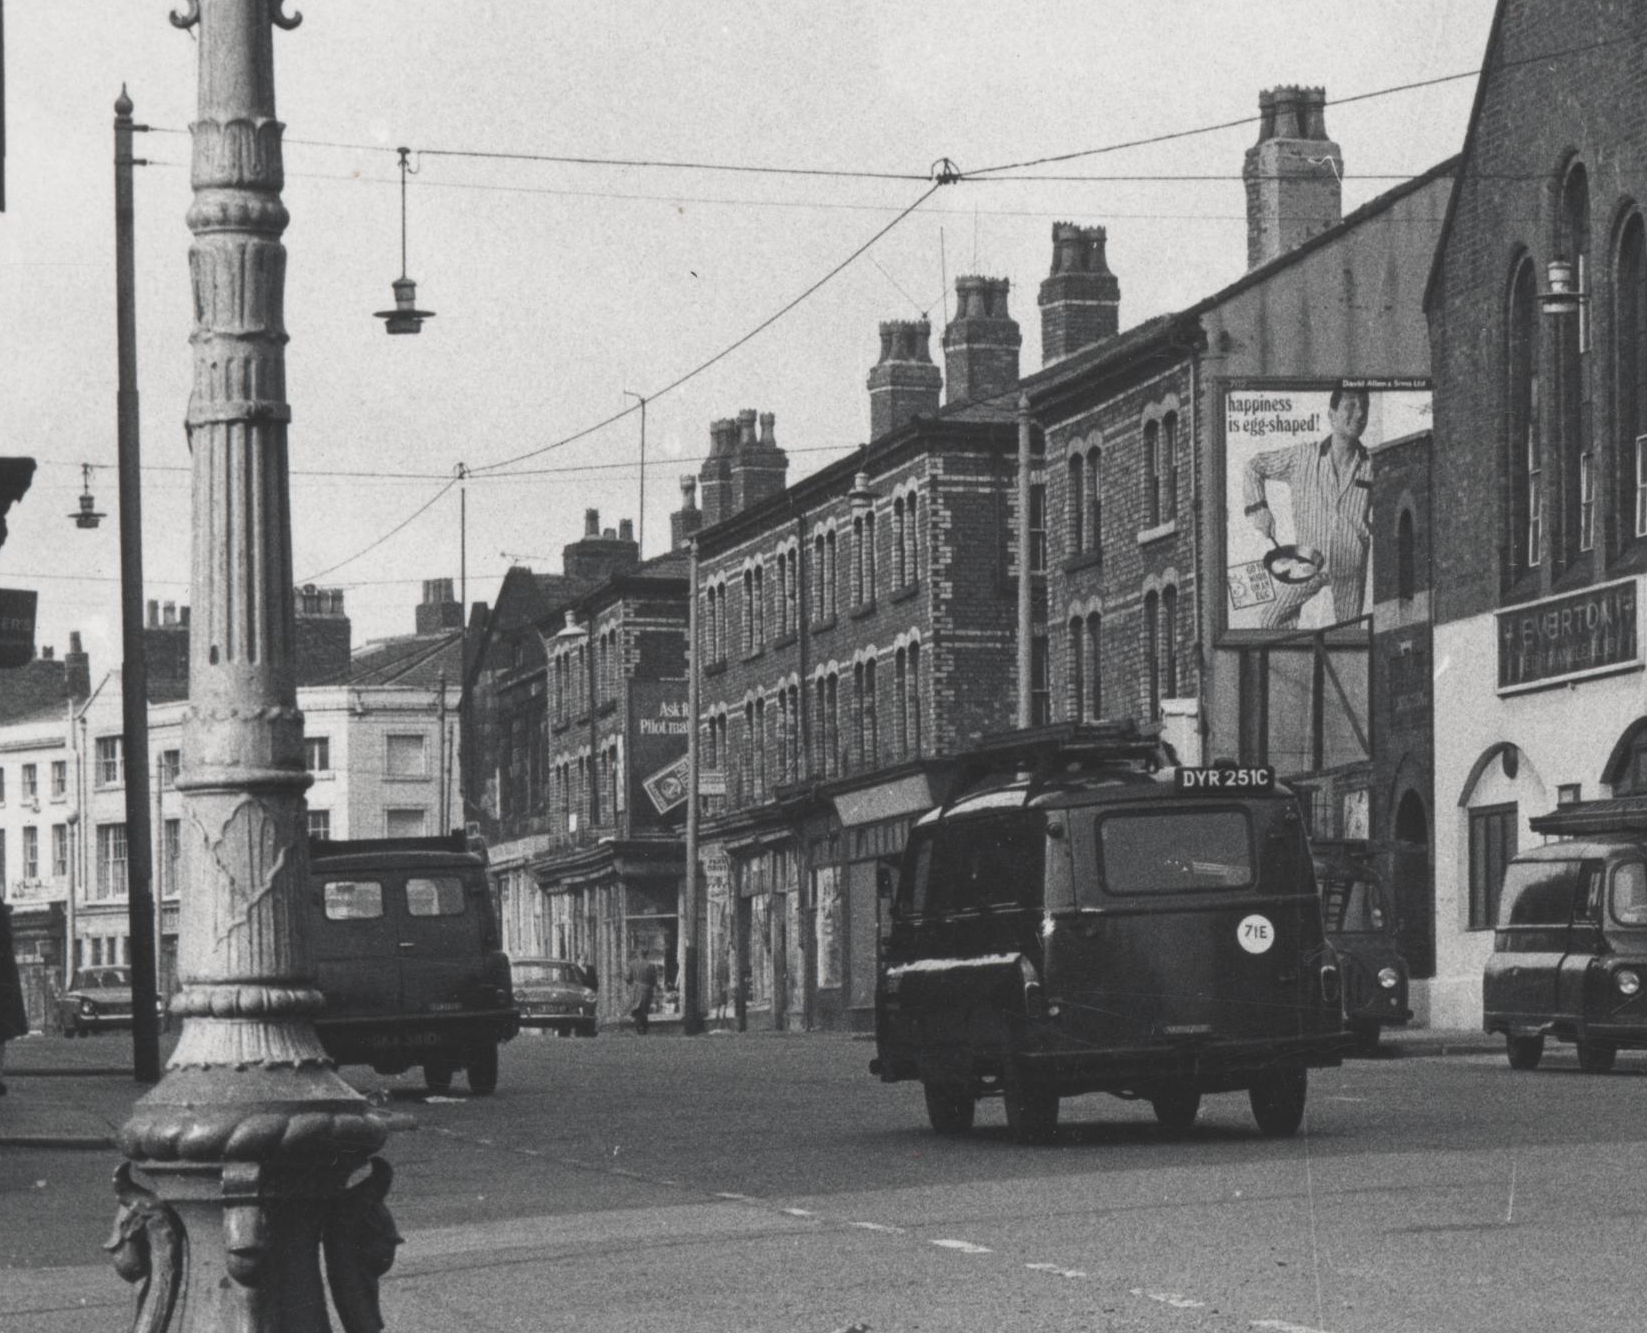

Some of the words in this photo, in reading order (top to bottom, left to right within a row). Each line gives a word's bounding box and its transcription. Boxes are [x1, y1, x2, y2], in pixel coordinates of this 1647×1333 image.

[1228, 393, 1293, 416] happiness
[1228, 415, 1241, 433] is
[1242, 413, 1322, 437] egg-shaped!
[659, 702, 679, 718] Ask
[640, 718, 665, 735] Pilot
[1183, 769, 1220, 788] DYR
[1224, 768, 1269, 787] 251C
[1245, 923, 1268, 940] 71E
